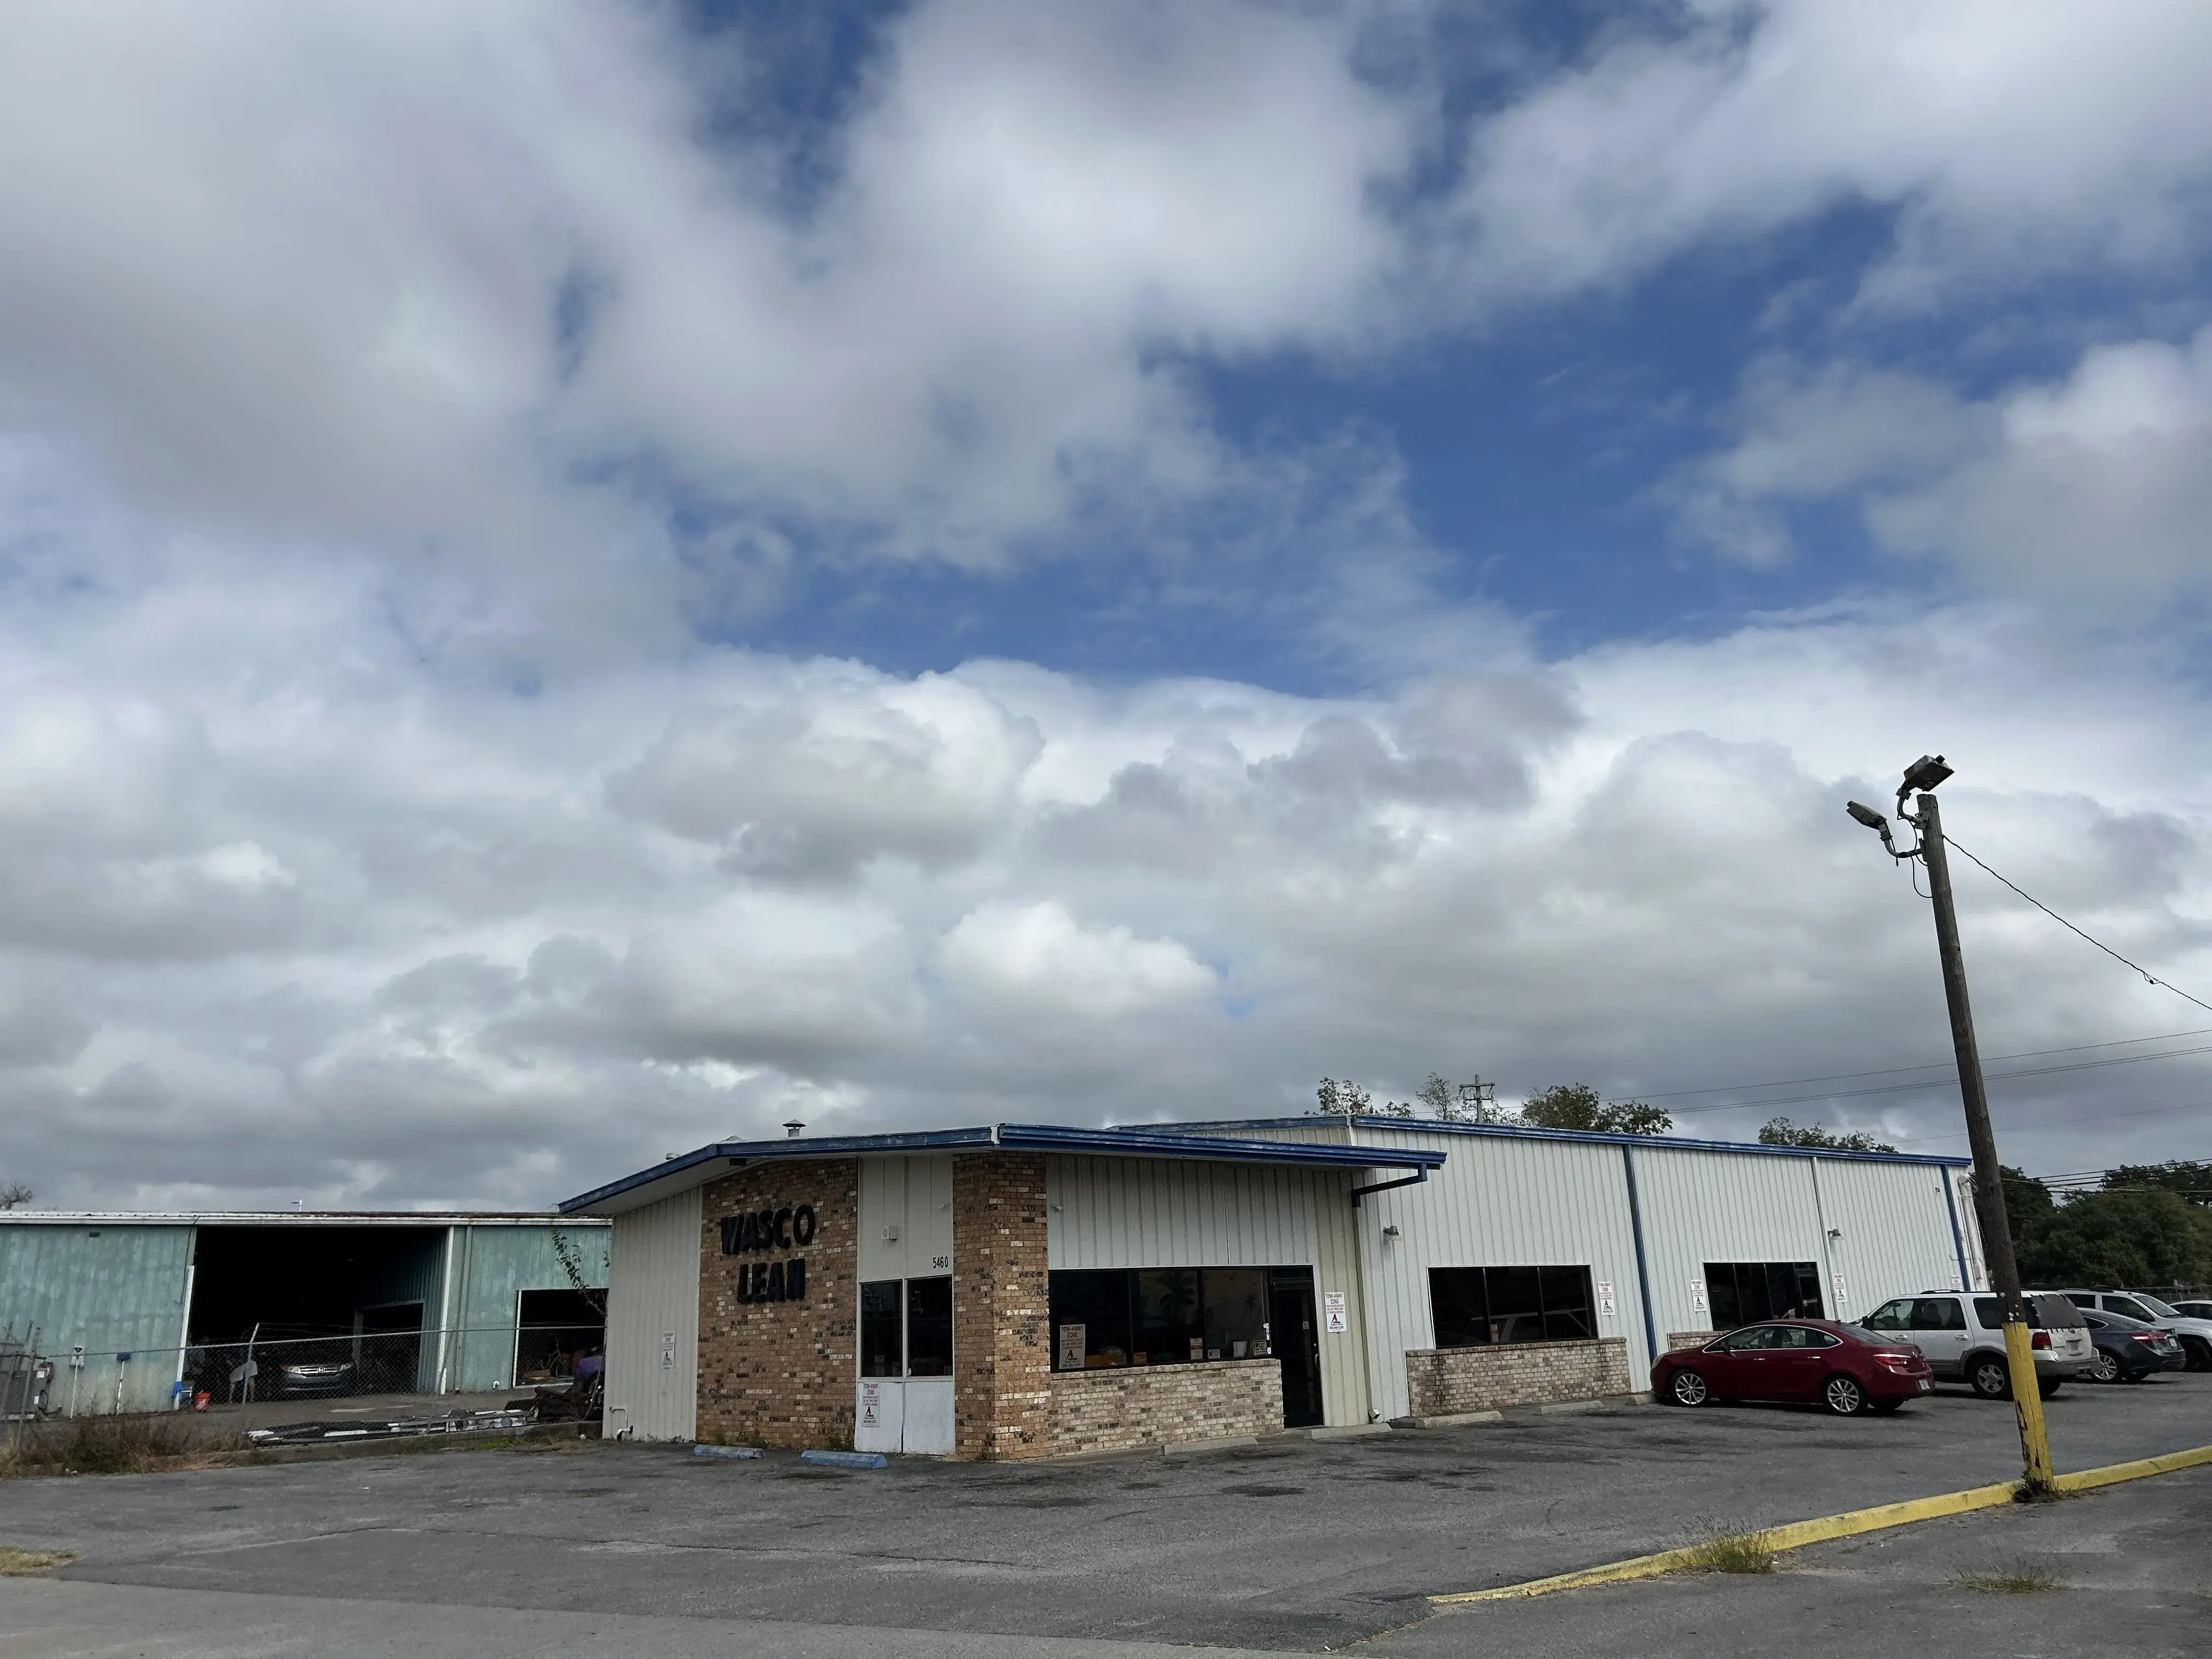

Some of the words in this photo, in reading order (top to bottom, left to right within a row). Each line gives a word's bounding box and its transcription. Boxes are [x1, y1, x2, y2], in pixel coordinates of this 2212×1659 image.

[721, 1205, 816, 1255] WASCO
[737, 1258, 806, 1305] LEAN
[933, 1256, 949, 1268] 5460
